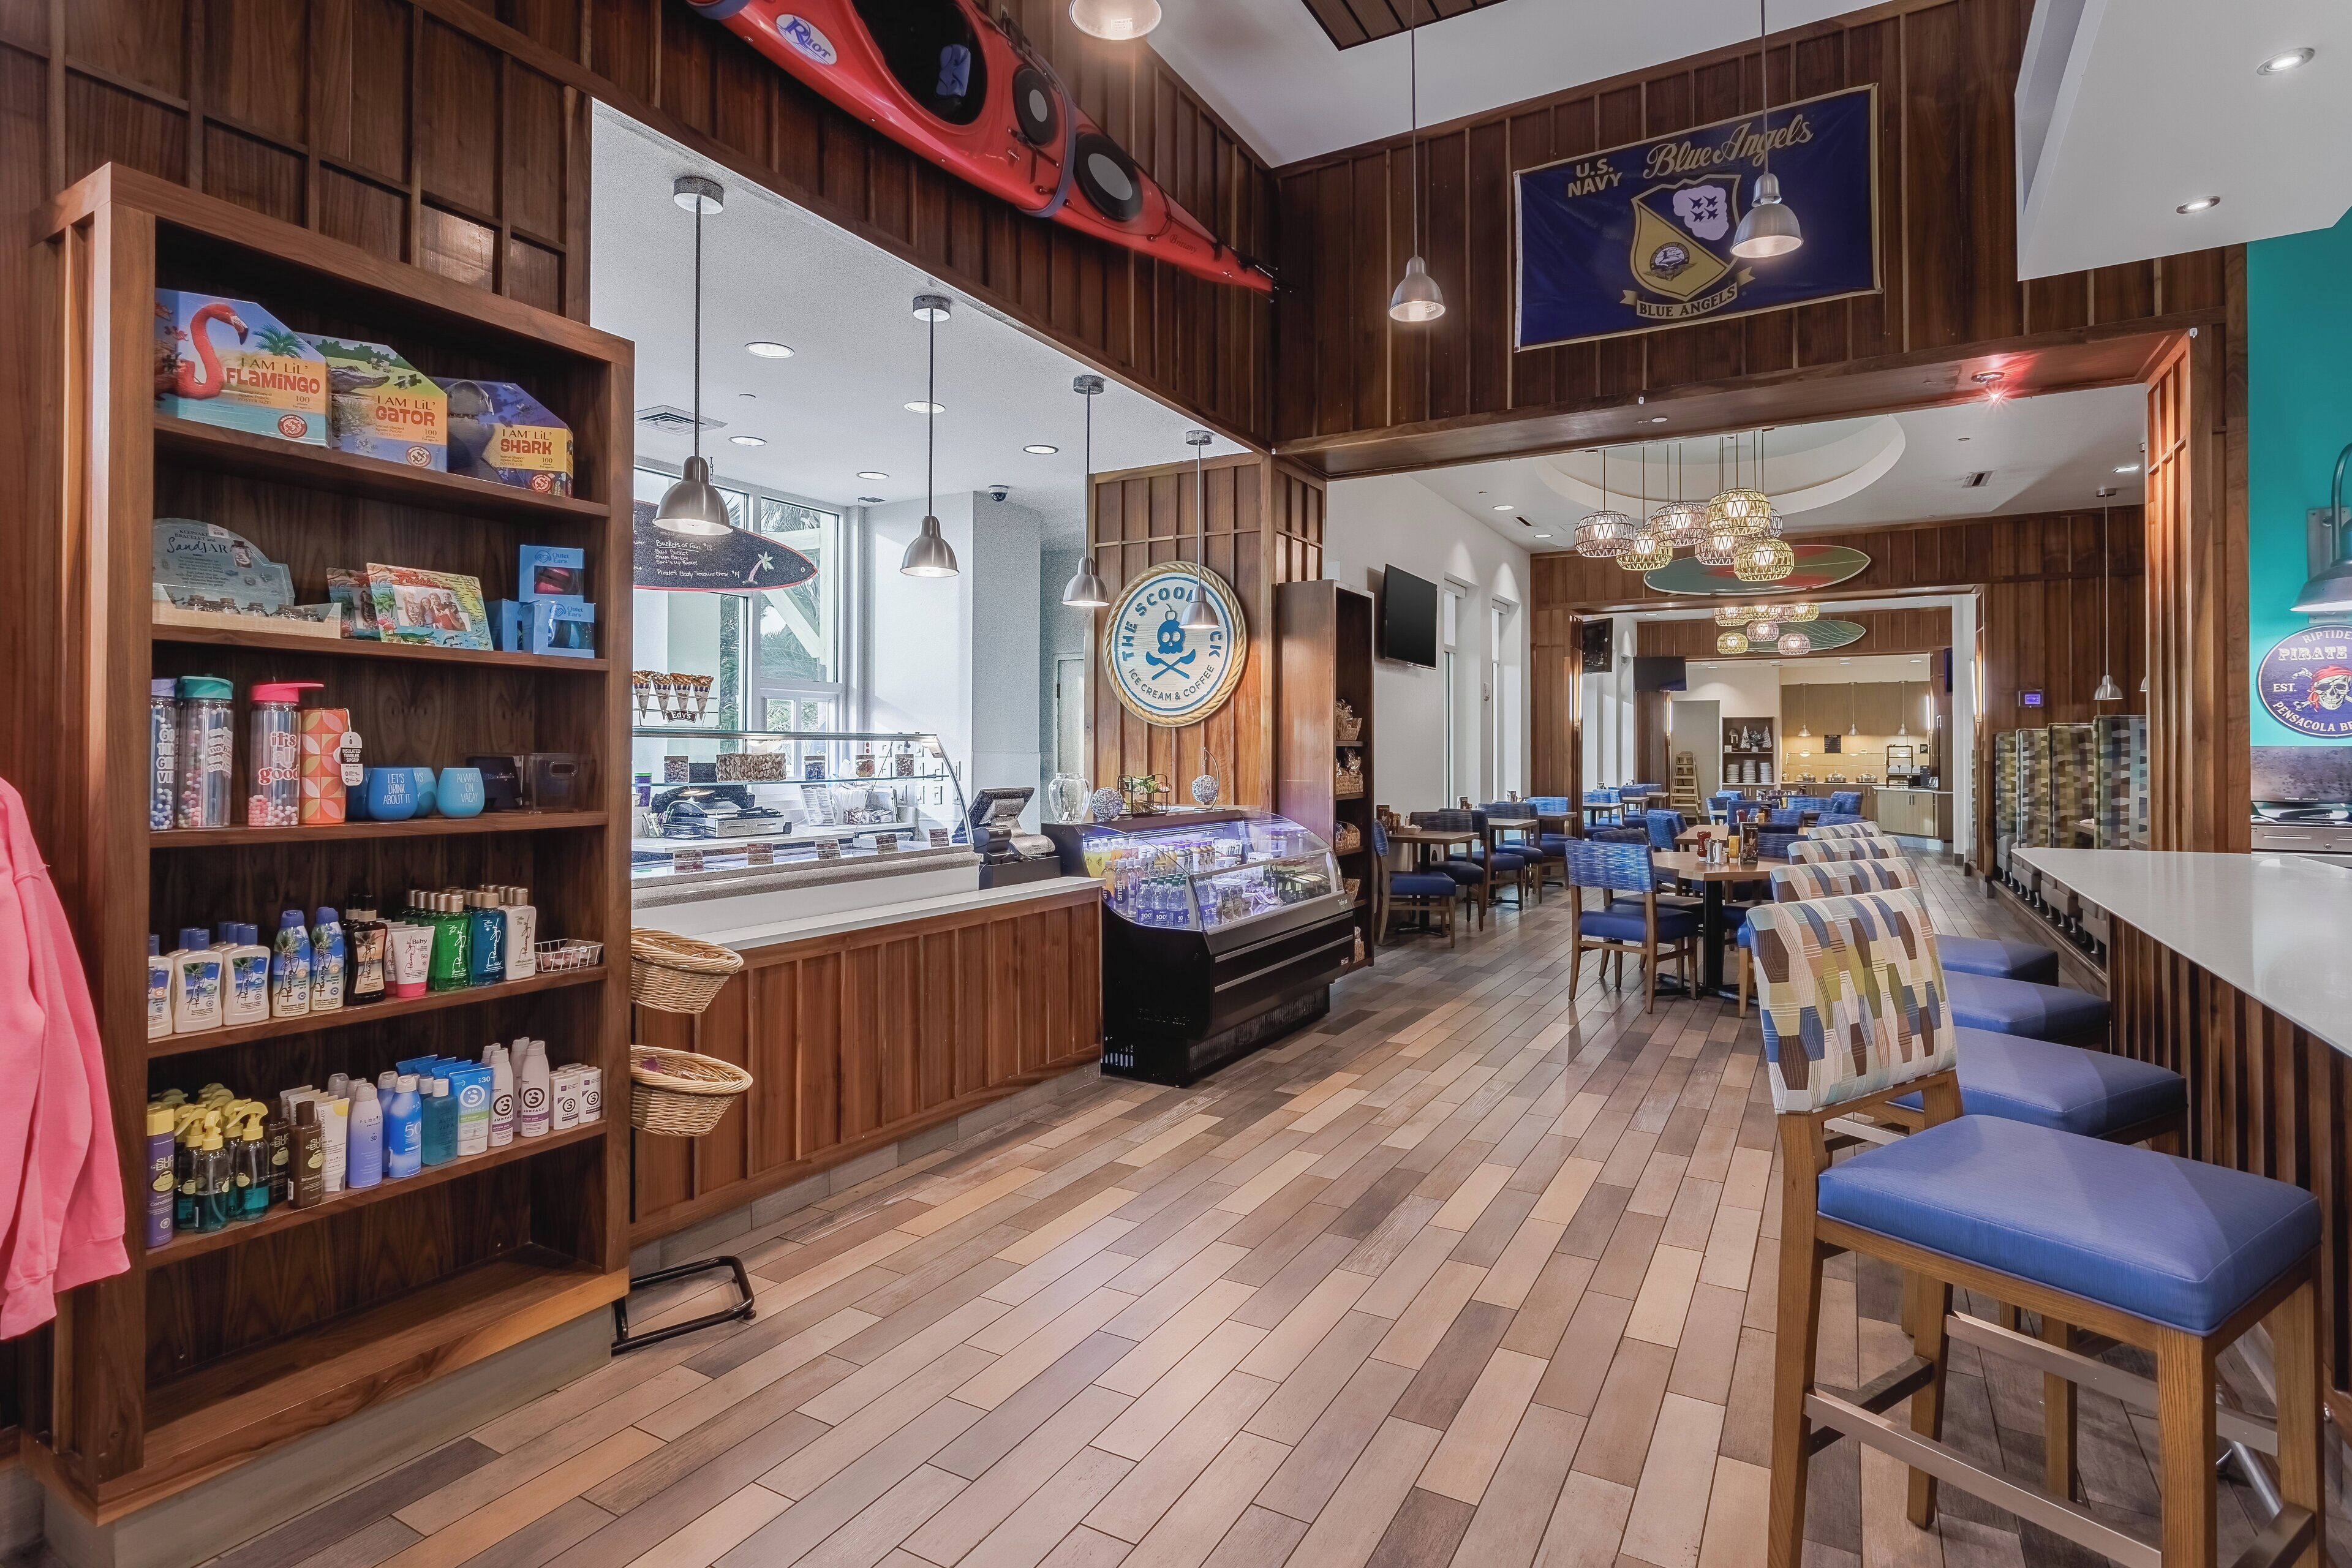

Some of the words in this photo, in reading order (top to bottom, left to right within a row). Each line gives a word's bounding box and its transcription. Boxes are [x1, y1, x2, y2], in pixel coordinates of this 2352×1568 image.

[785, 16, 831, 58] RIOT
[1643, 140, 1712, 179] Blue
[1713, 113, 1814, 167] Angels
[1575, 158, 1614, 178] U.S.
[1567, 172, 1623, 197] NAVY
[1639, 302, 1674, 317] BLUE
[1679, 285, 1736, 317] ANGELS
[241, 357, 244, 367] I
[250, 359, 275, 371] AM
[377, 395, 380, 404] I
[385, 396, 407, 407] AM
[508, 430, 527, 439] AM
[202, 542, 228, 554] JAR
[731, 570, 740, 579] $14
[1121, 620, 1138, 662] THE
[1208, 630, 1223, 658] CK
[2278, 645, 2348, 661] PIRATE
[1128, 668, 1142, 686] ICE
[1141, 683, 1172, 701] CREAM
[1175, 692, 1181, 700] &
[1183, 665, 1215, 698] COFFEE
[2272, 683, 2297, 692] EST.
[2272, 700, 2337, 732] PENSACOLA
[271, 733, 296, 747] it's
[260, 765, 299, 784] good
[387, 773, 405, 785] LET'S
[456, 773, 479, 783] ALWAYS
[388, 784, 405, 794] DRINK
[464, 783, 473, 793] ON
[383, 794, 404, 805] ABOUT
[405, 793, 411, 804] IT
[460, 793, 478, 803] VACAY
[404, 1122, 421, 1137] 50
[301, 1174, 320, 1182] Browning
